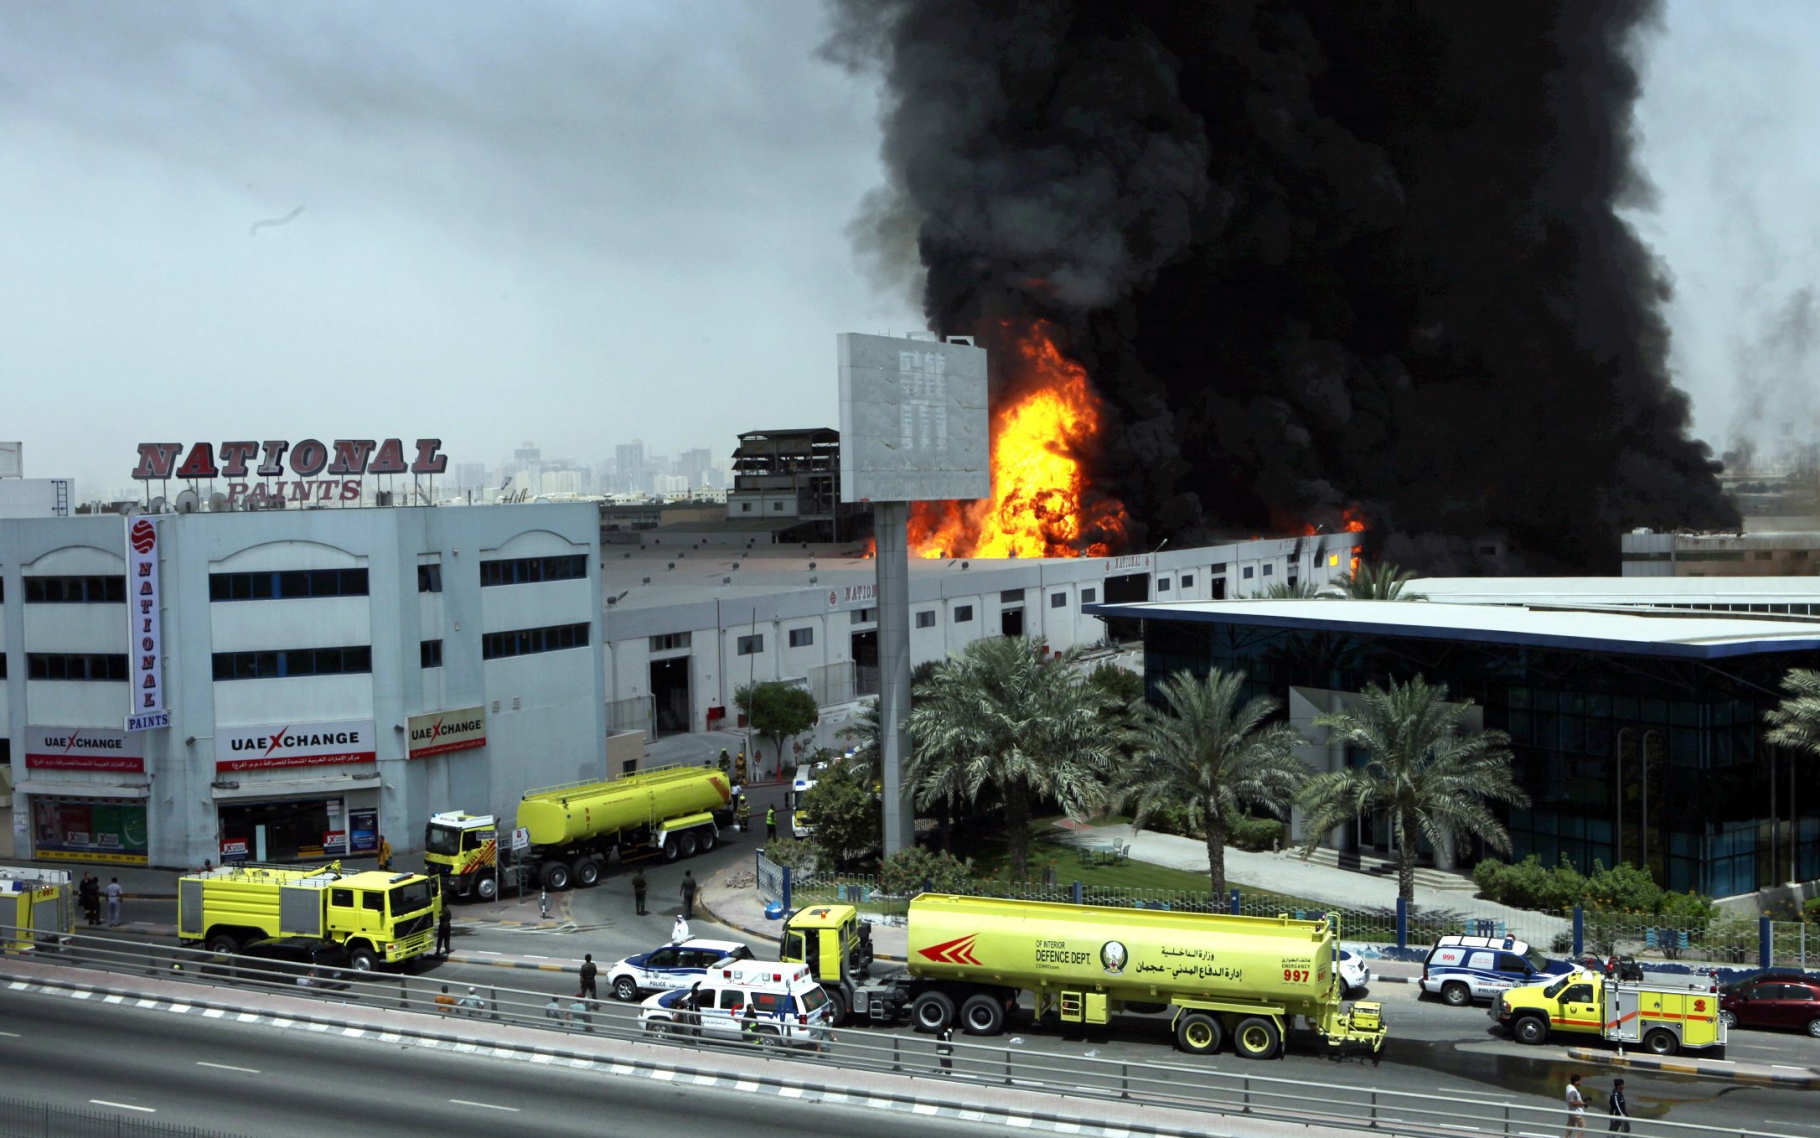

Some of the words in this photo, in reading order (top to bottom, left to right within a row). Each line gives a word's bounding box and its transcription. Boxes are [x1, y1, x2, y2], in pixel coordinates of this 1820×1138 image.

[131, 438, 447, 480] NATIONAL
[224, 479, 361, 503] PAINTS
[138, 562, 156, 707] NATIONAL
[129, 714, 168, 730] PAINTS
[1043, 940, 1065, 949] INTERIOR
[1161, 946, 1198, 958] الداخلية
[1036, 949, 1069, 963] DEFENCE
[1071, 951, 1091, 965] DEPT.
[1198, 950, 1215, 961] وزارة
[1442, 953, 1455, 961] 999
[1136, 961, 1165, 974] عجمان
[1199, 964, 1224, 979] الدفاع
[1283, 968, 1310, 983] 997
[1693, 999, 1706, 1012] 2
